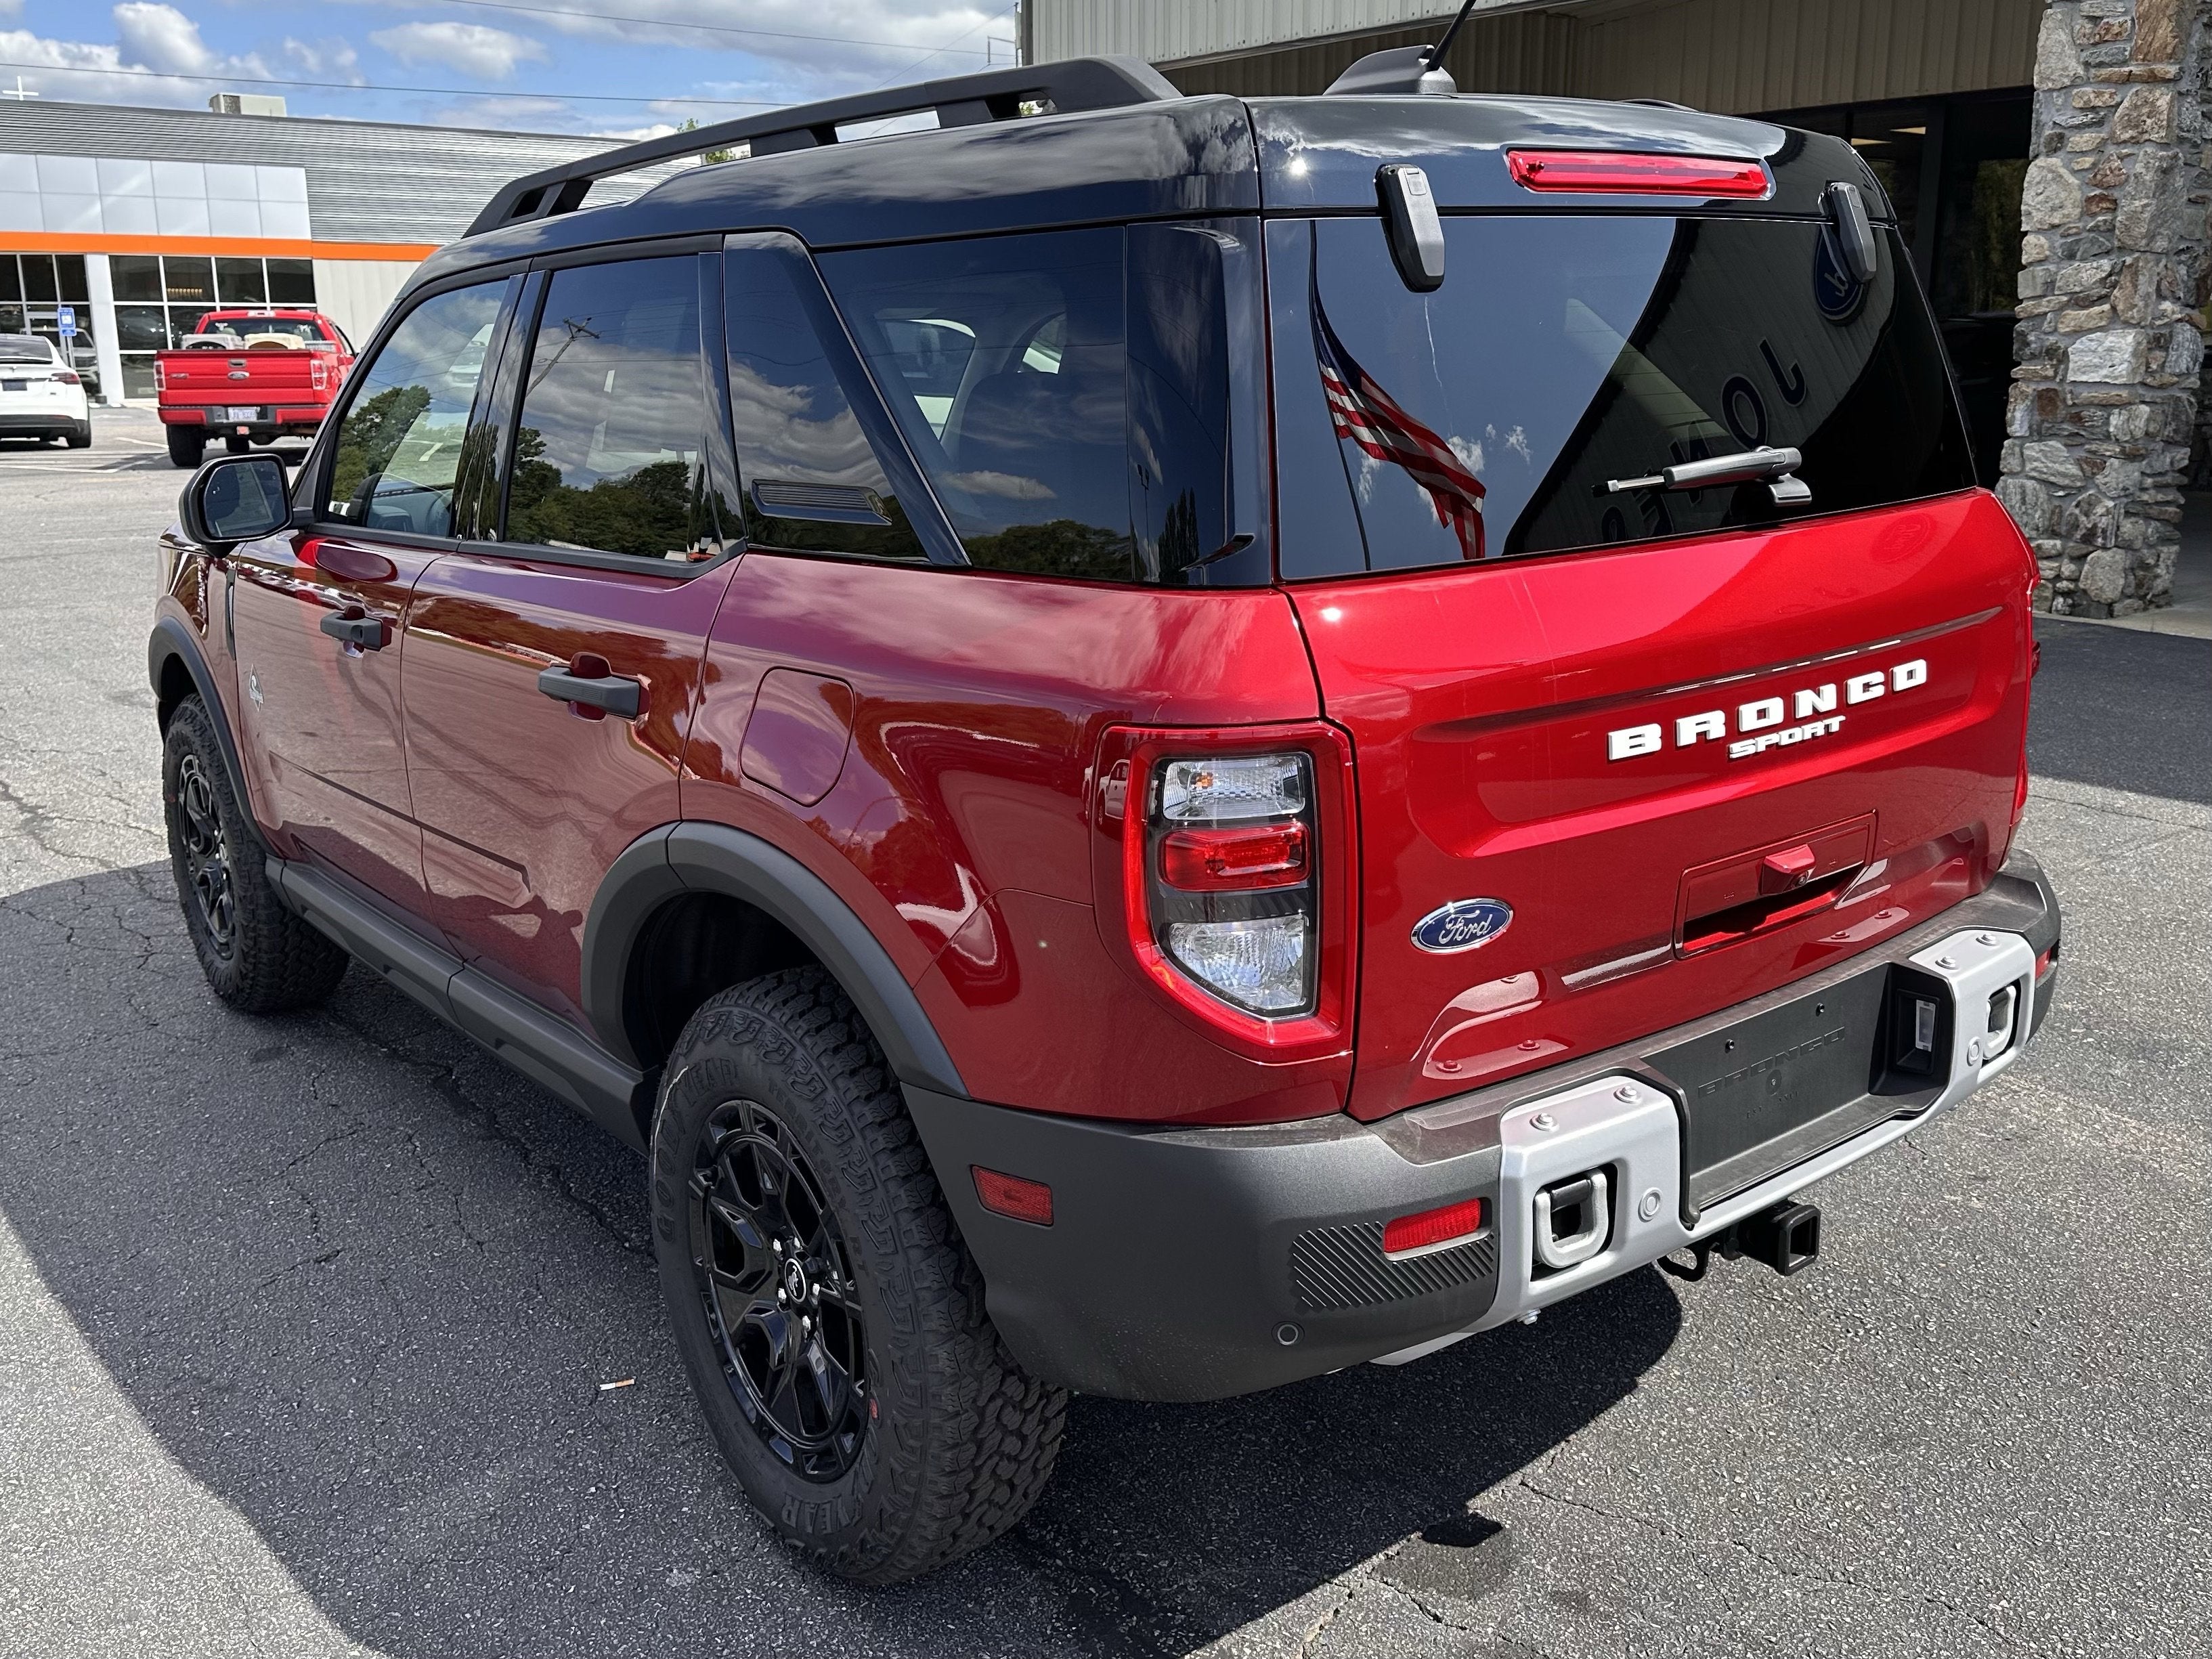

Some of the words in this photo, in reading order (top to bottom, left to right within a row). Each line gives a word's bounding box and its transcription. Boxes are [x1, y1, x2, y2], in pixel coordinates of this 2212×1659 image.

[1607, 658, 1928, 762] BRONCO
[1728, 714, 1846, 759] SPORT
[1439, 909, 1493, 944] Ford
[1697, 1026, 1846, 1098] BRONCO
